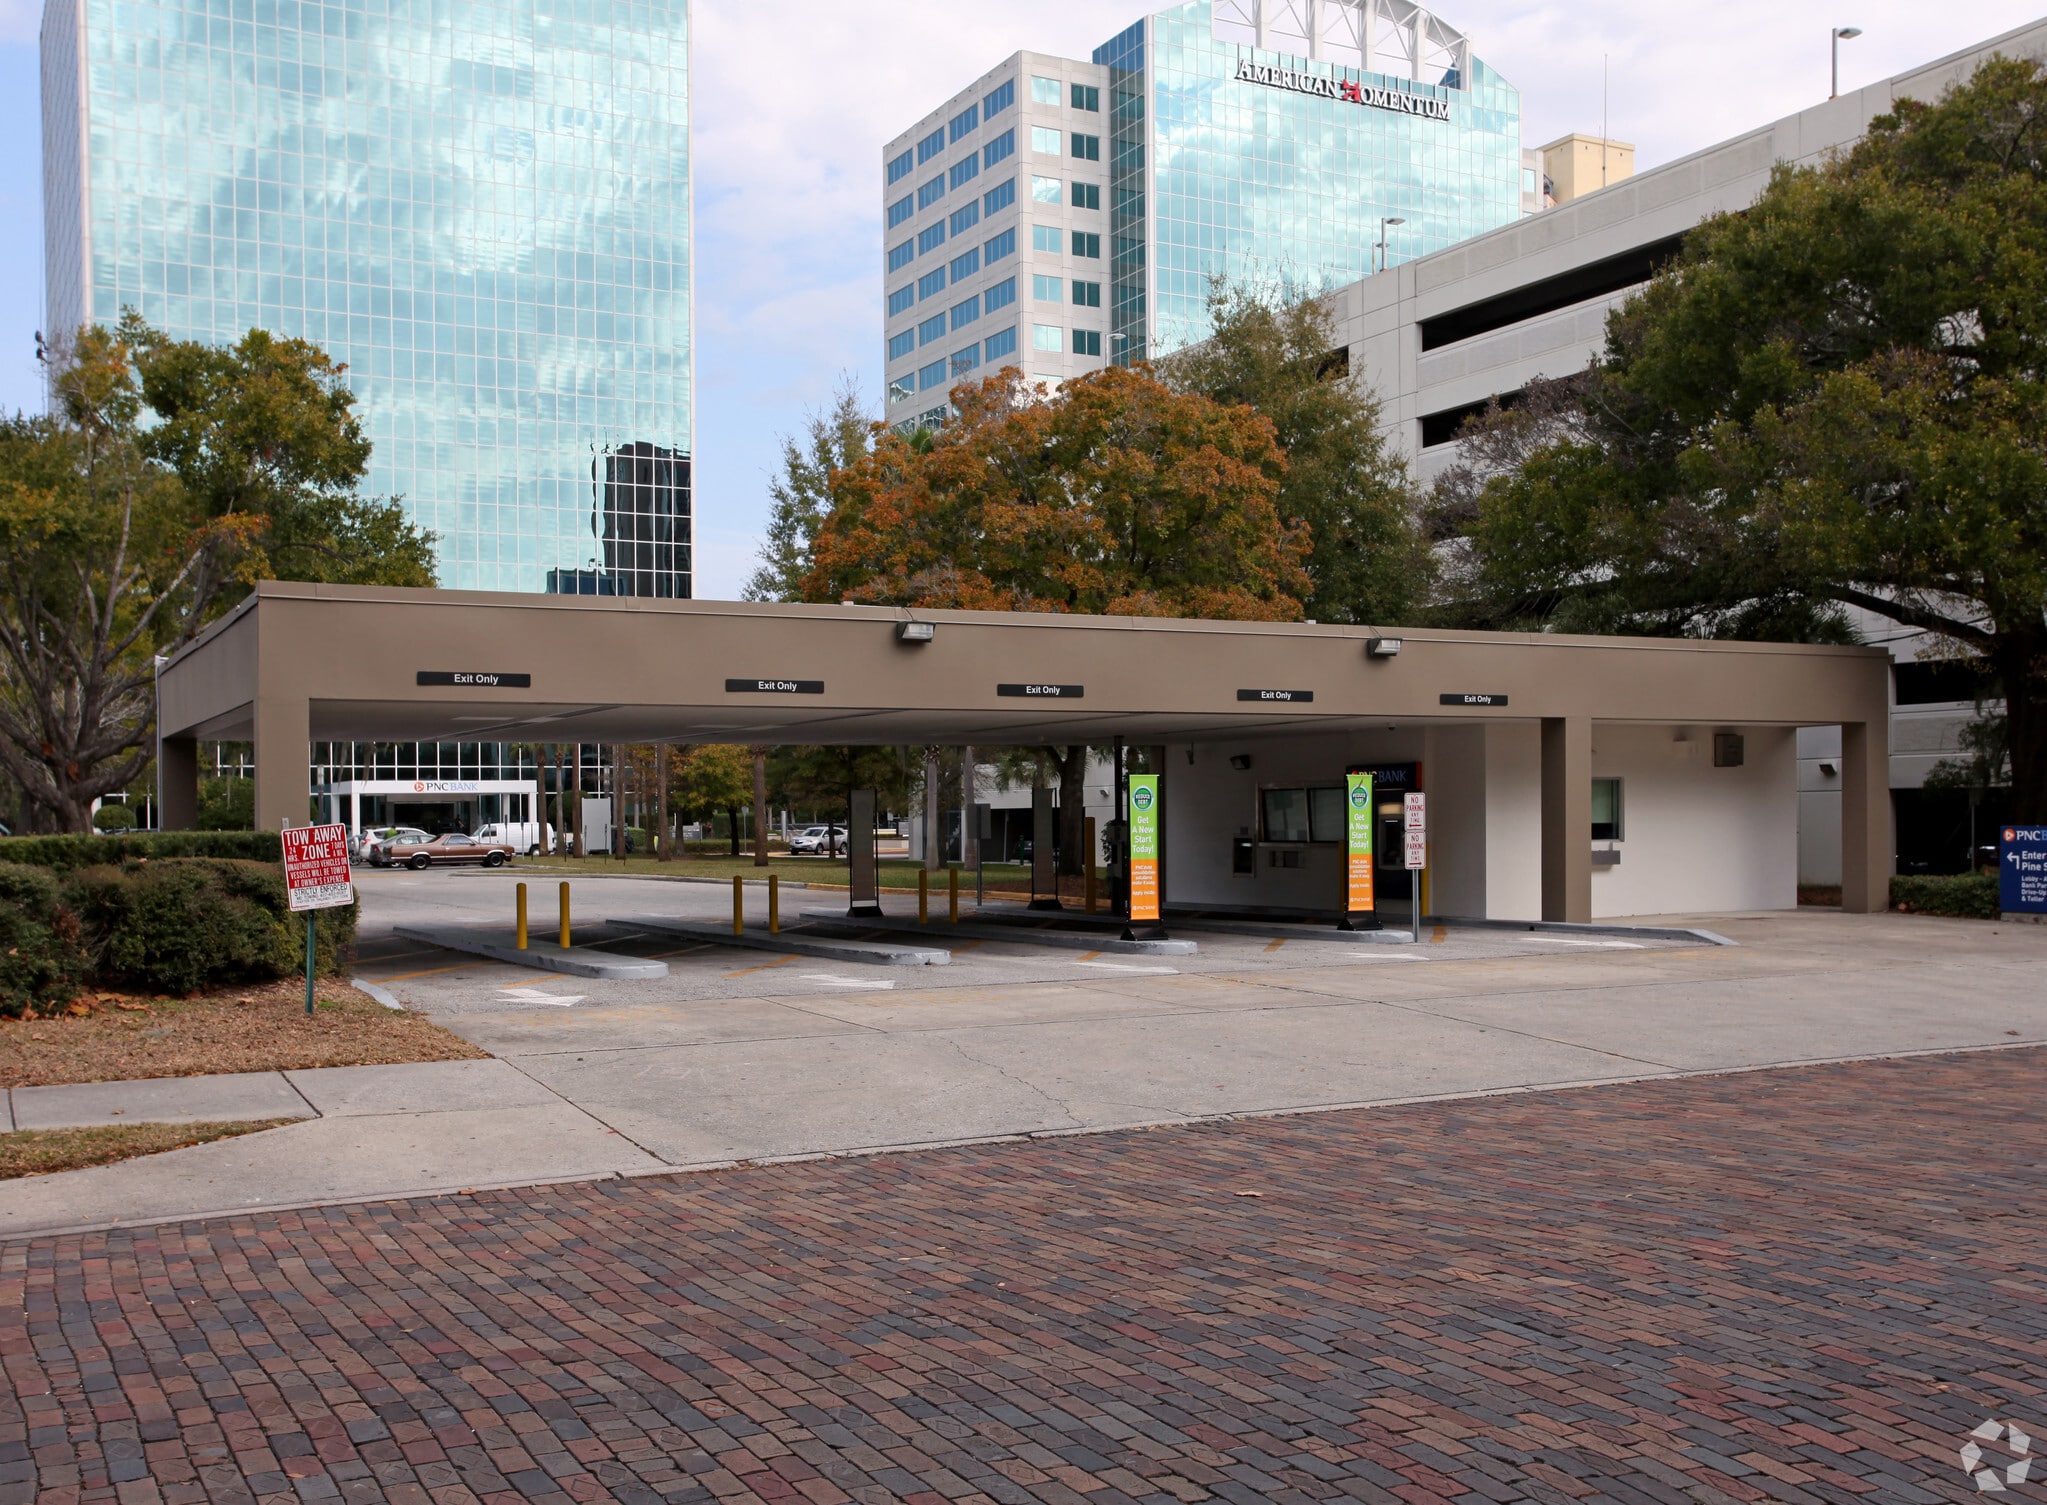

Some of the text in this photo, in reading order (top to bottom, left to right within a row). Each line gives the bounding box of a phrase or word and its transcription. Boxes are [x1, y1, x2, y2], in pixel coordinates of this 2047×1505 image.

[1236, 59, 1338, 98] AMERICAN
[454, 674, 499, 685] Exit Only
[758, 681, 797, 692] Exit Only
[1026, 686, 1060, 696] Exit Only
[1261, 691, 1291, 700] Exit Only
[1477, 696, 1491, 704] Only
[1378, 770, 1408, 783] BANK
[426, 782, 478, 791] PNC BANK
[285, 826, 342, 846] TOW AWAY
[2016, 830, 2040, 840] PNC
[302, 843, 330, 860] ZONE
[1133, 845, 1154, 854] Today!
[2022, 851, 2047, 860] Enter
[288, 861, 320, 871] UNAUTHORIZED
[320, 858, 341, 868] VEHICLES
[2022, 862, 2041, 871] Pine
[290, 870, 311, 880] VESSELS
[312, 869, 322, 877] WILL
[331, 866, 346, 875] TOWED
[324, 875, 344, 884] EXPENSE
[294, 887, 318, 896] STRICTLY
[320, 883, 347, 893] ENFORCED
